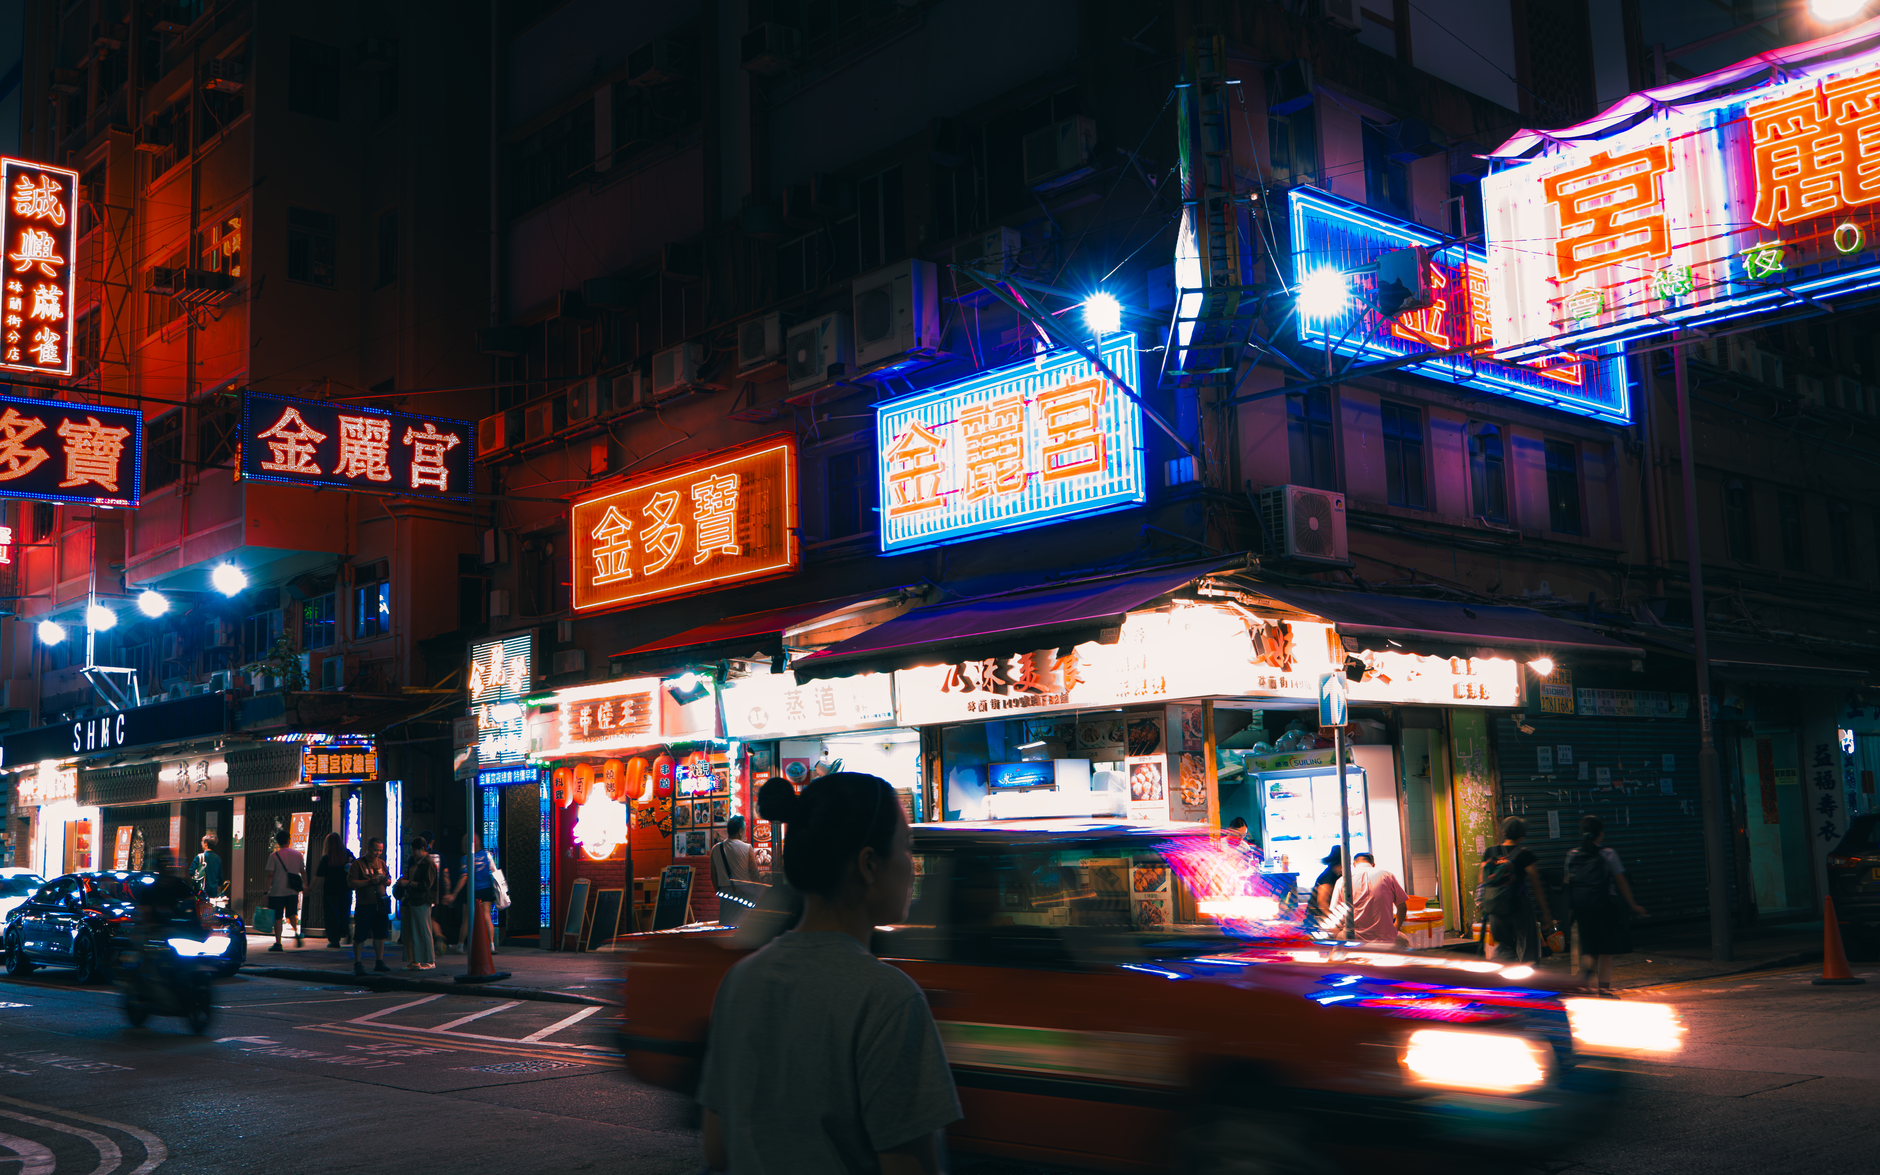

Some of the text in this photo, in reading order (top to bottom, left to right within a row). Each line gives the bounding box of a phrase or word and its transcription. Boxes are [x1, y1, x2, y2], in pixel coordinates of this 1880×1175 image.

[0, 407, 131, 492] 多寶
[257, 406, 461, 491] 金麗宮
[886, 376, 1108, 518] 金麗宮
[591, 473, 741, 587] 金多寶
[784, 685, 837, 721] 蒸道
[1541, 696, 1573, 713] 27811682
[1812, 743, 1841, 842] 益福壽衣
